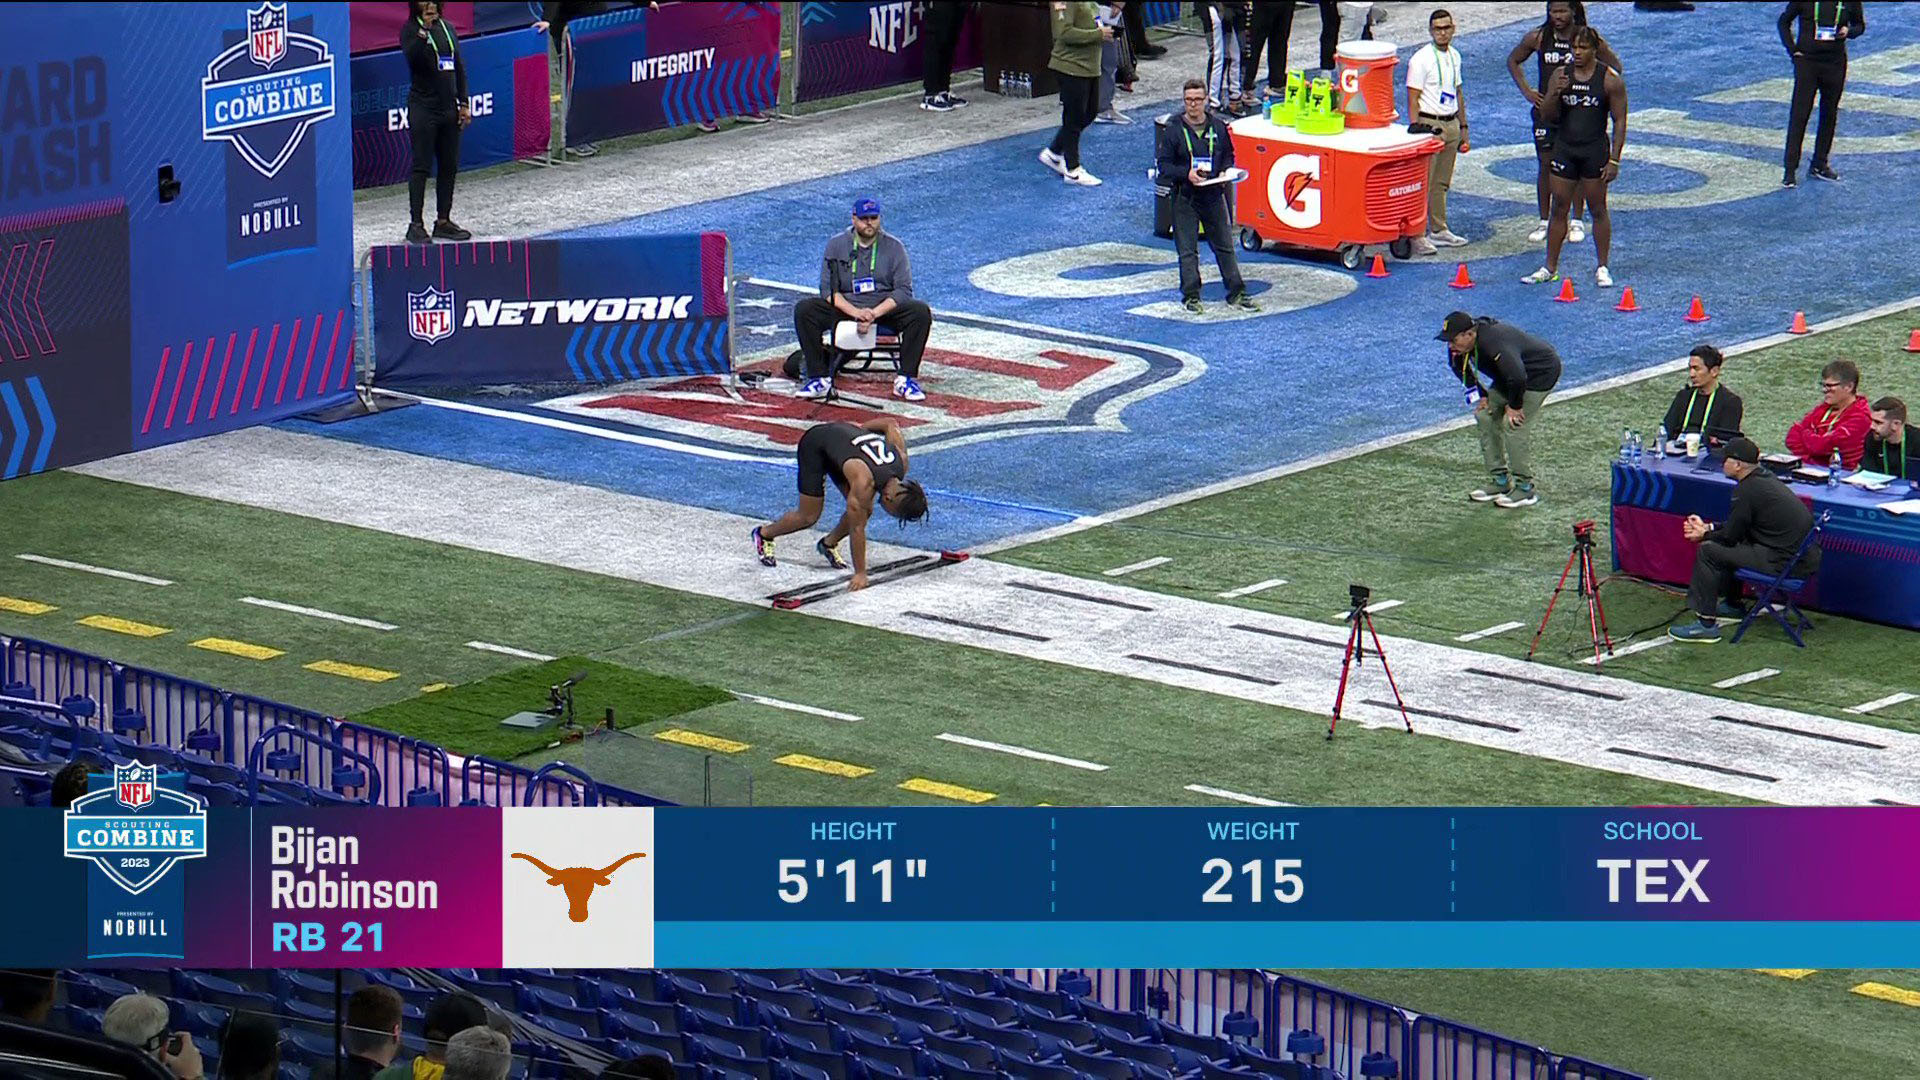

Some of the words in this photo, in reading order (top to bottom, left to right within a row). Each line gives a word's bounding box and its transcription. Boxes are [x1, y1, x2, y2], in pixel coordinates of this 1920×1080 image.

[255, 30, 282, 59] NFL
[1543, 51, 1575, 63] RB-2
[631, 47, 715, 83] INTEGRITY
[1341, 69, 1359, 93] G
[0, 55, 107, 133] ARD
[214, 82, 323, 123] COMBINE
[240, 76, 301, 96] SCOUTING
[0, 119, 111, 200] ASH
[1267, 153, 1321, 228] G
[1388, 181, 1422, 197] GATORADE
[241, 203, 301, 236] NOBULL
[415, 312, 449, 337] NFL
[462, 295, 693, 328] NETWORK
[860, 440, 895, 466] 21
